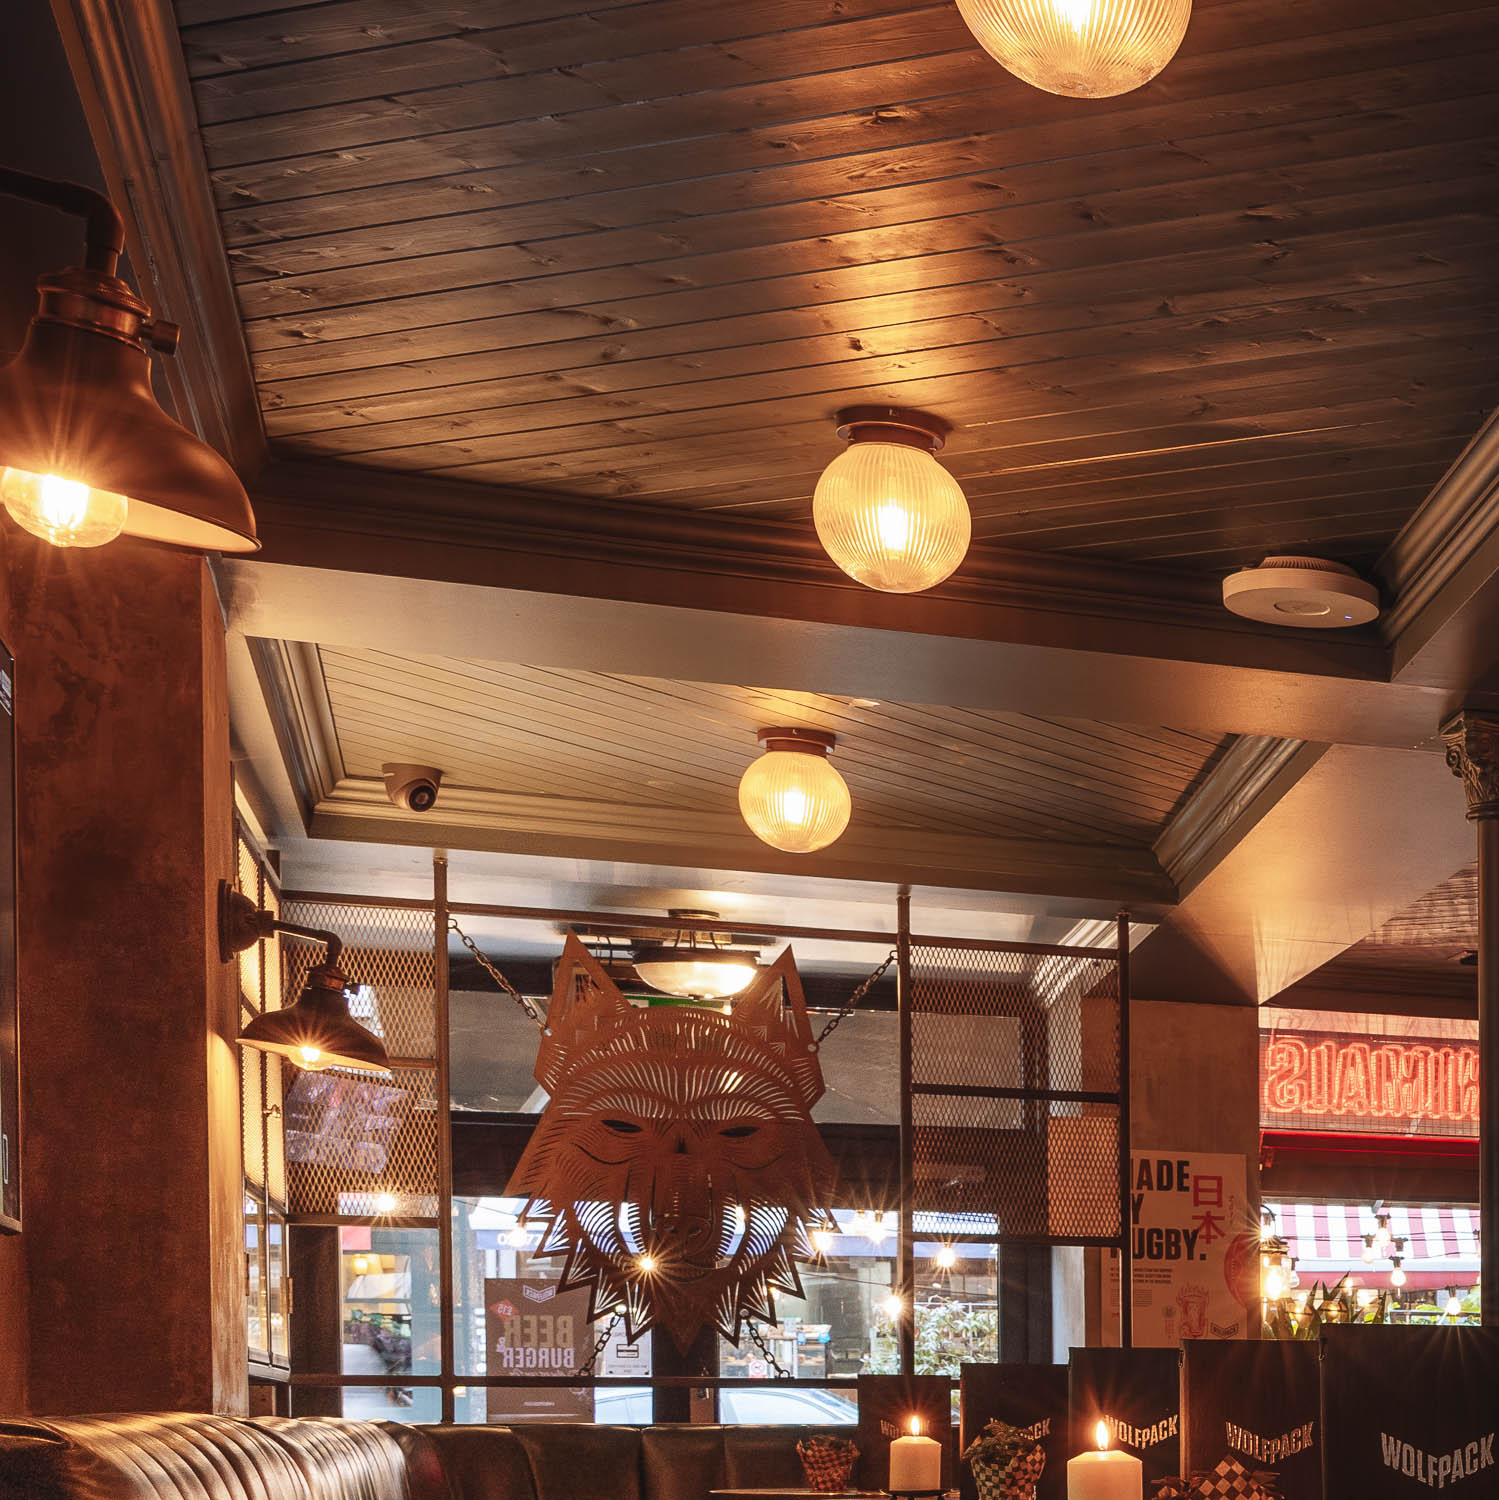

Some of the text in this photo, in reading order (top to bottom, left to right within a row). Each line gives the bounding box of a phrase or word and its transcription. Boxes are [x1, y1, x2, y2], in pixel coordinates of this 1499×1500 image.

[1130, 1158, 1190, 1192] ADE
[1130, 1193, 1145, 1224] Y
[1192, 1175, 1226, 1245] 日本
[1110, 1228, 1207, 1261] UGBY.
[1103, 1414, 1178, 1450] WOLFPACK
[1226, 1421, 1314, 1464] WOLFPACK
[1381, 1432, 1495, 1489] WOLFPACK
